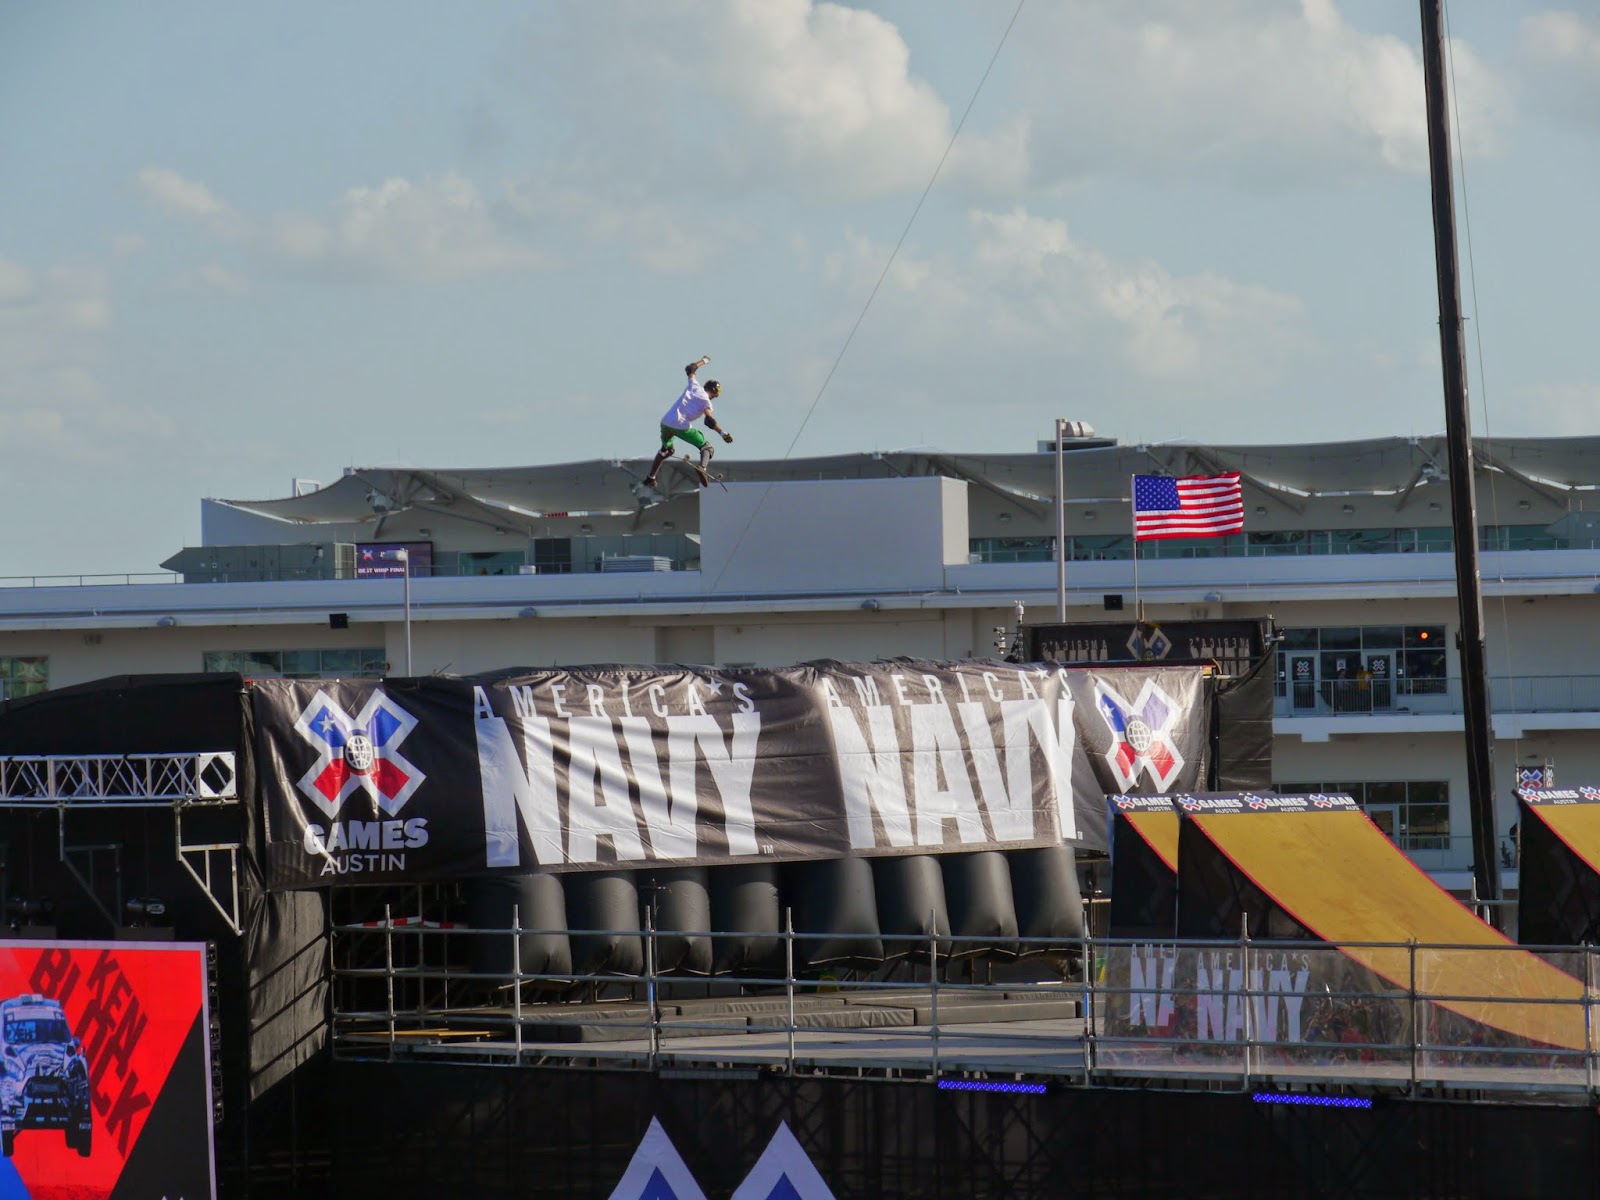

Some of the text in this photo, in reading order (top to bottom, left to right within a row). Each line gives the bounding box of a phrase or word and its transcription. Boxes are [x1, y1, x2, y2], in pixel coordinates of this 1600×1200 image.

[828, 698, 1077, 849] NAVY
[474, 711, 761, 868] NAVY
[1537, 790, 1579, 799] GAMES
[1131, 796, 1173, 806] GAMES
[1198, 798, 1243, 808] GAMES
[1264, 797, 1308, 807] GAMES
[304, 818, 429, 855] GAMES
[320, 854, 406, 876] AUSTIN
[1197, 969, 1310, 1042] NAVY
